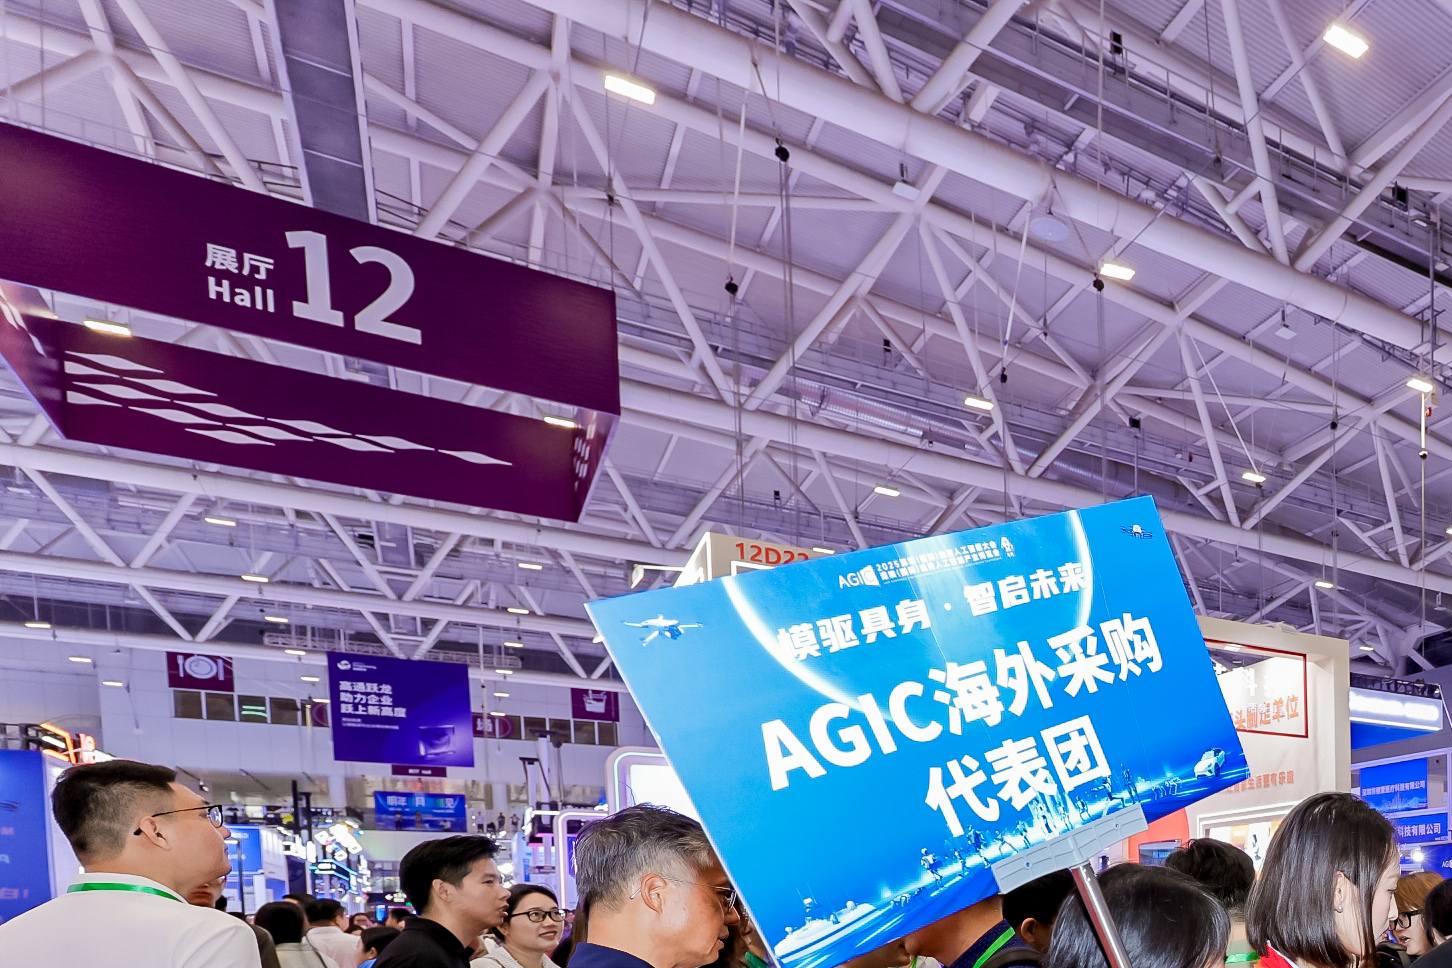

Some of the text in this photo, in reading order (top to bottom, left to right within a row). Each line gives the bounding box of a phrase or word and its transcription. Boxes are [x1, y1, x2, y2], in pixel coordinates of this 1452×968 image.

[204, 243, 274, 280] 展厅
[207, 276, 275, 313] Hall
[285, 229, 422, 345] 12
[761, 612, 1163, 791] AGIC海外采购
[925, 715, 1111, 837] 代表团
